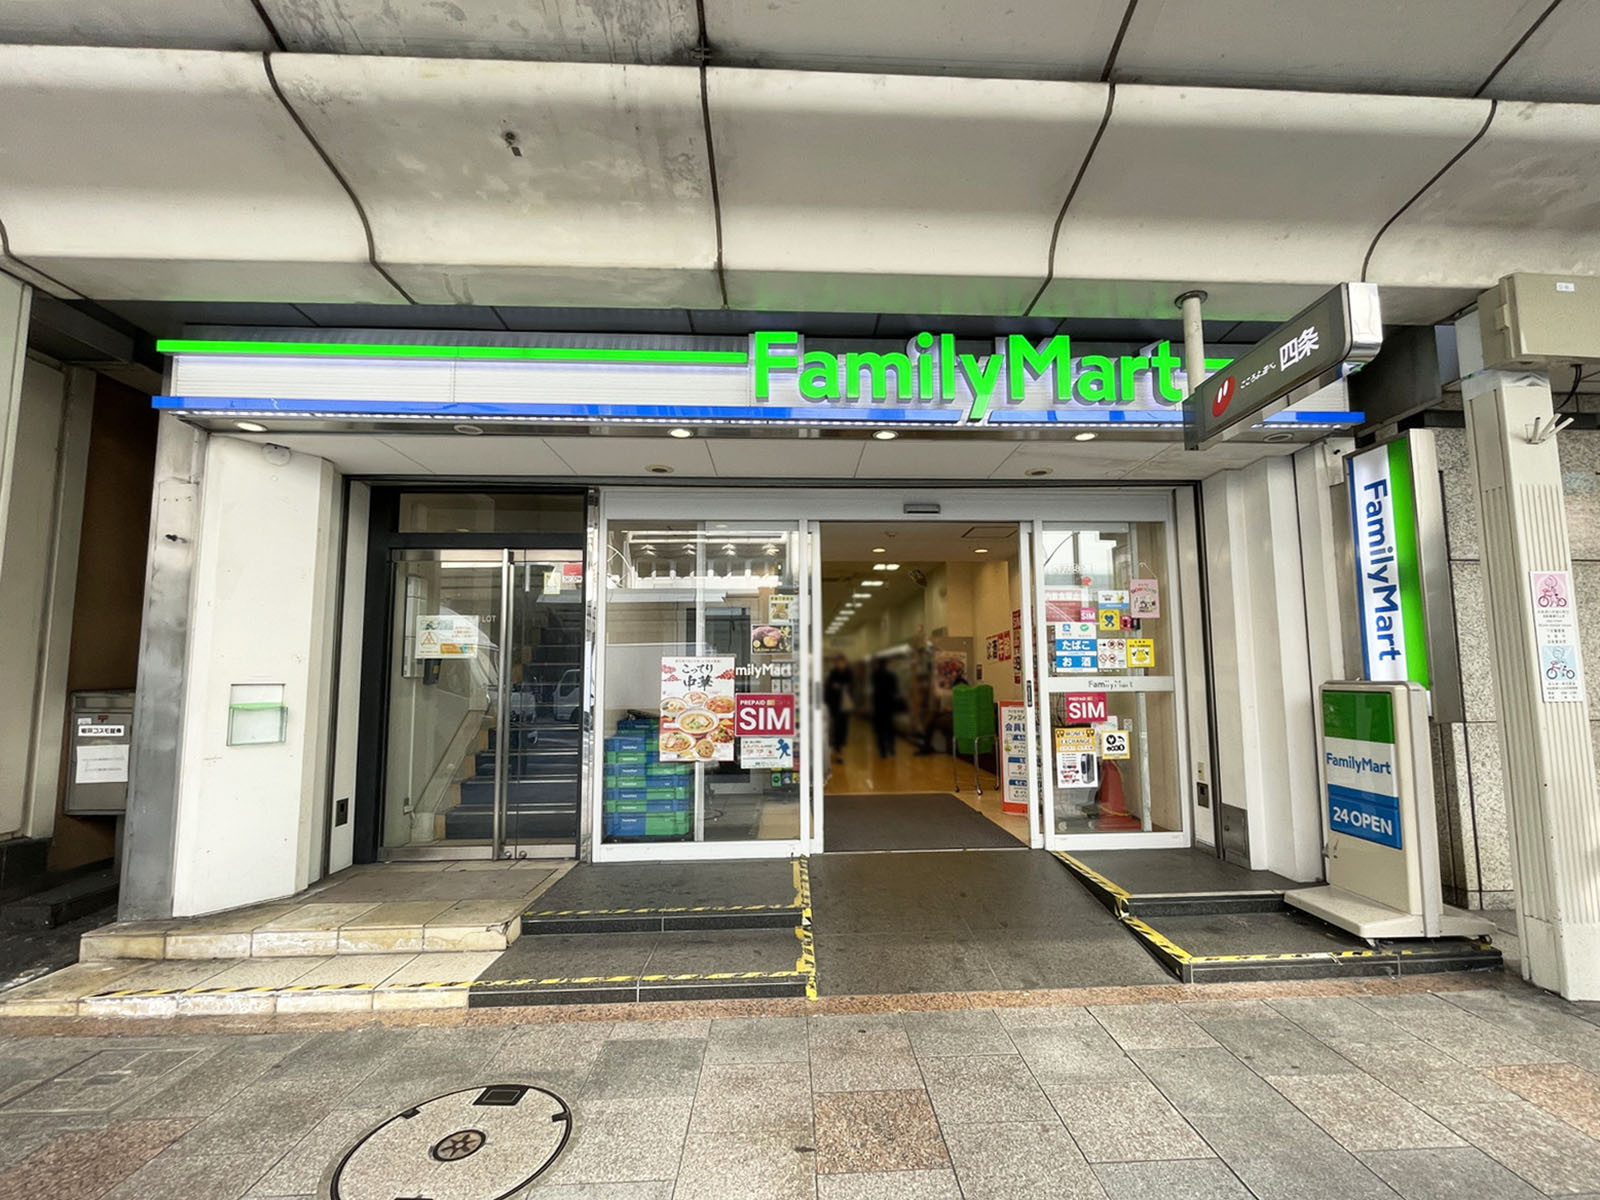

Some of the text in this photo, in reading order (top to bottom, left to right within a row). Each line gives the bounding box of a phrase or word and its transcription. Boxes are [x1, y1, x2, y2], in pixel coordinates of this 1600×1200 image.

[1279, 326, 1320, 372] 四条
[754, 331, 1183, 421] FamilyMart
[1363, 478, 1402, 661] FamilyMart
[1081, 612, 1096, 620] SIM
[1062, 640, 1091, 650] たばこ
[682, 664, 714, 674] こってり
[1062, 656, 1092, 668] お酒
[735, 664, 792, 679] milyMart
[683, 674, 714, 691] 中華
[739, 707, 791, 731] SIM
[1069, 702, 1105, 719] SIM
[1326, 752, 1391, 775] FamilyMart
